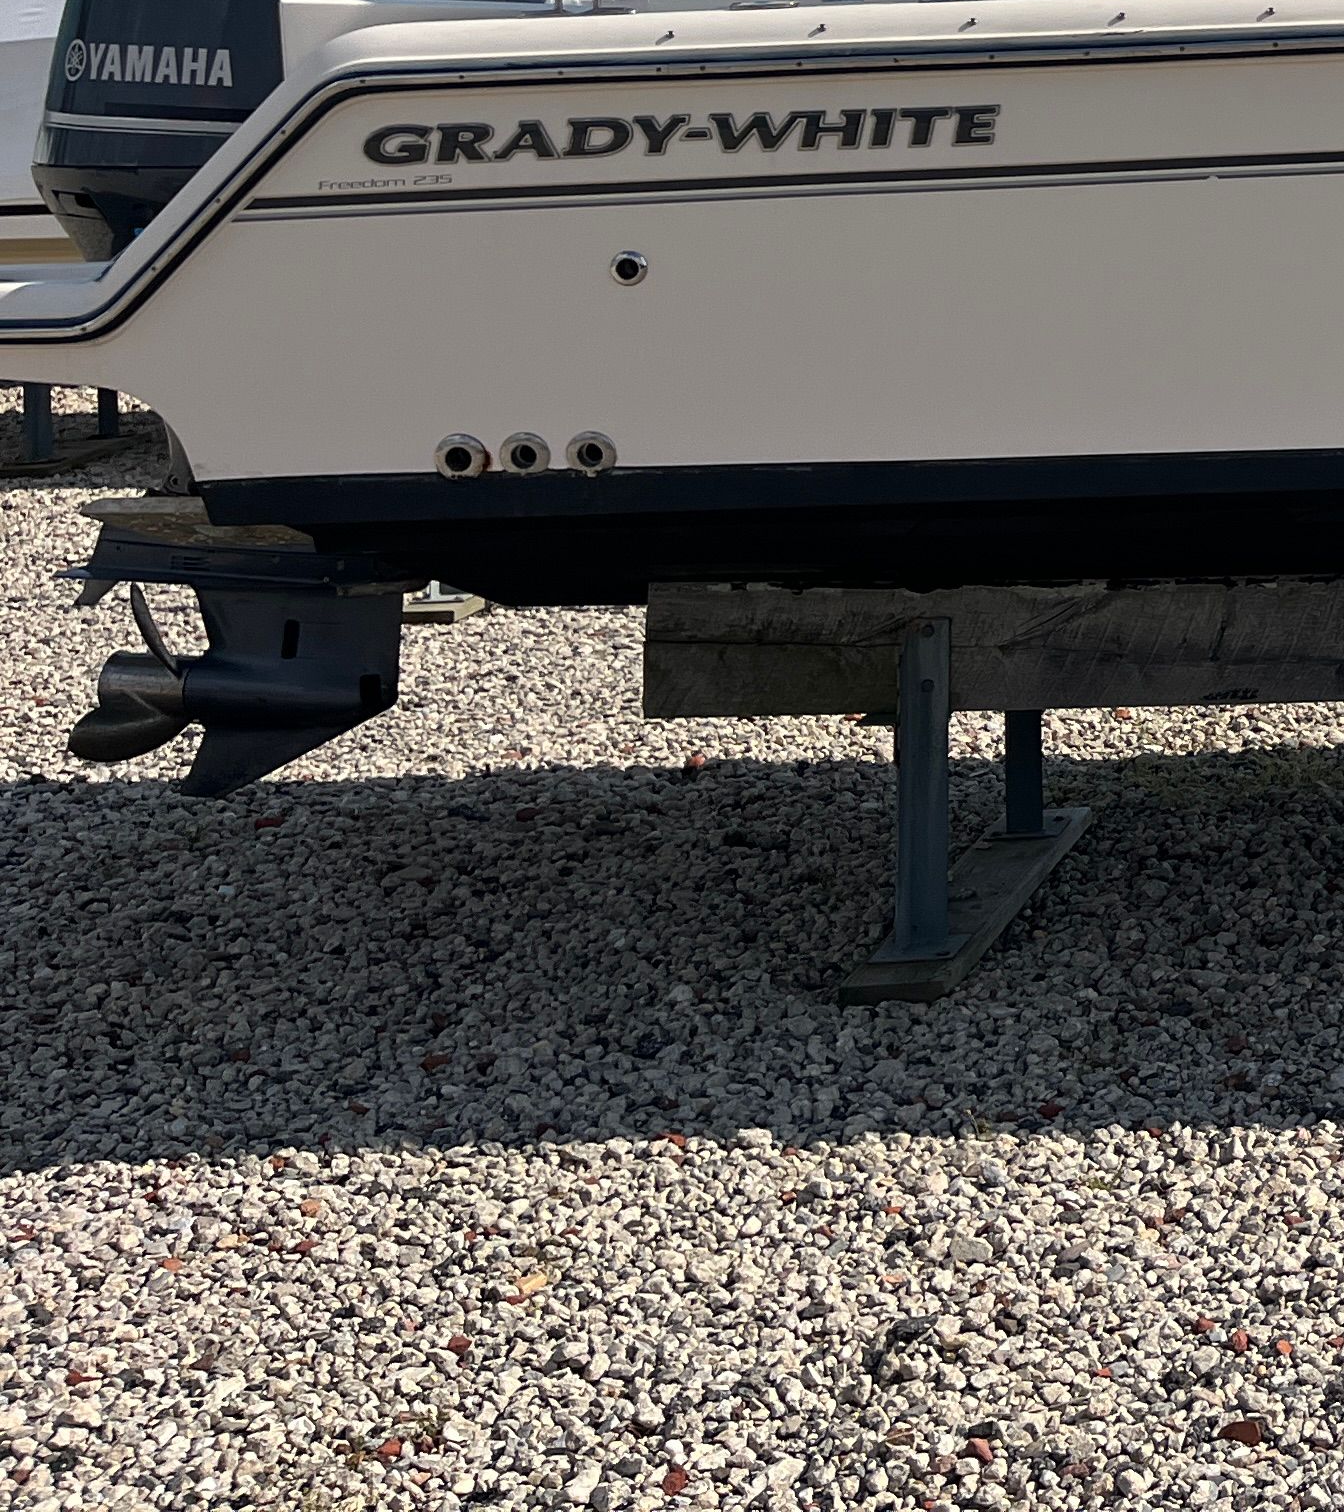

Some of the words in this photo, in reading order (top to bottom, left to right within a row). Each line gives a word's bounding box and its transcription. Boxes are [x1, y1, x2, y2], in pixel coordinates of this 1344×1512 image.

[89, 42, 233, 88] YAMAHA
[362, 103, 1001, 167] GRADY-WHITE
[318, 178, 406, 191] Freedom
[413, 174, 453, 186] 235
